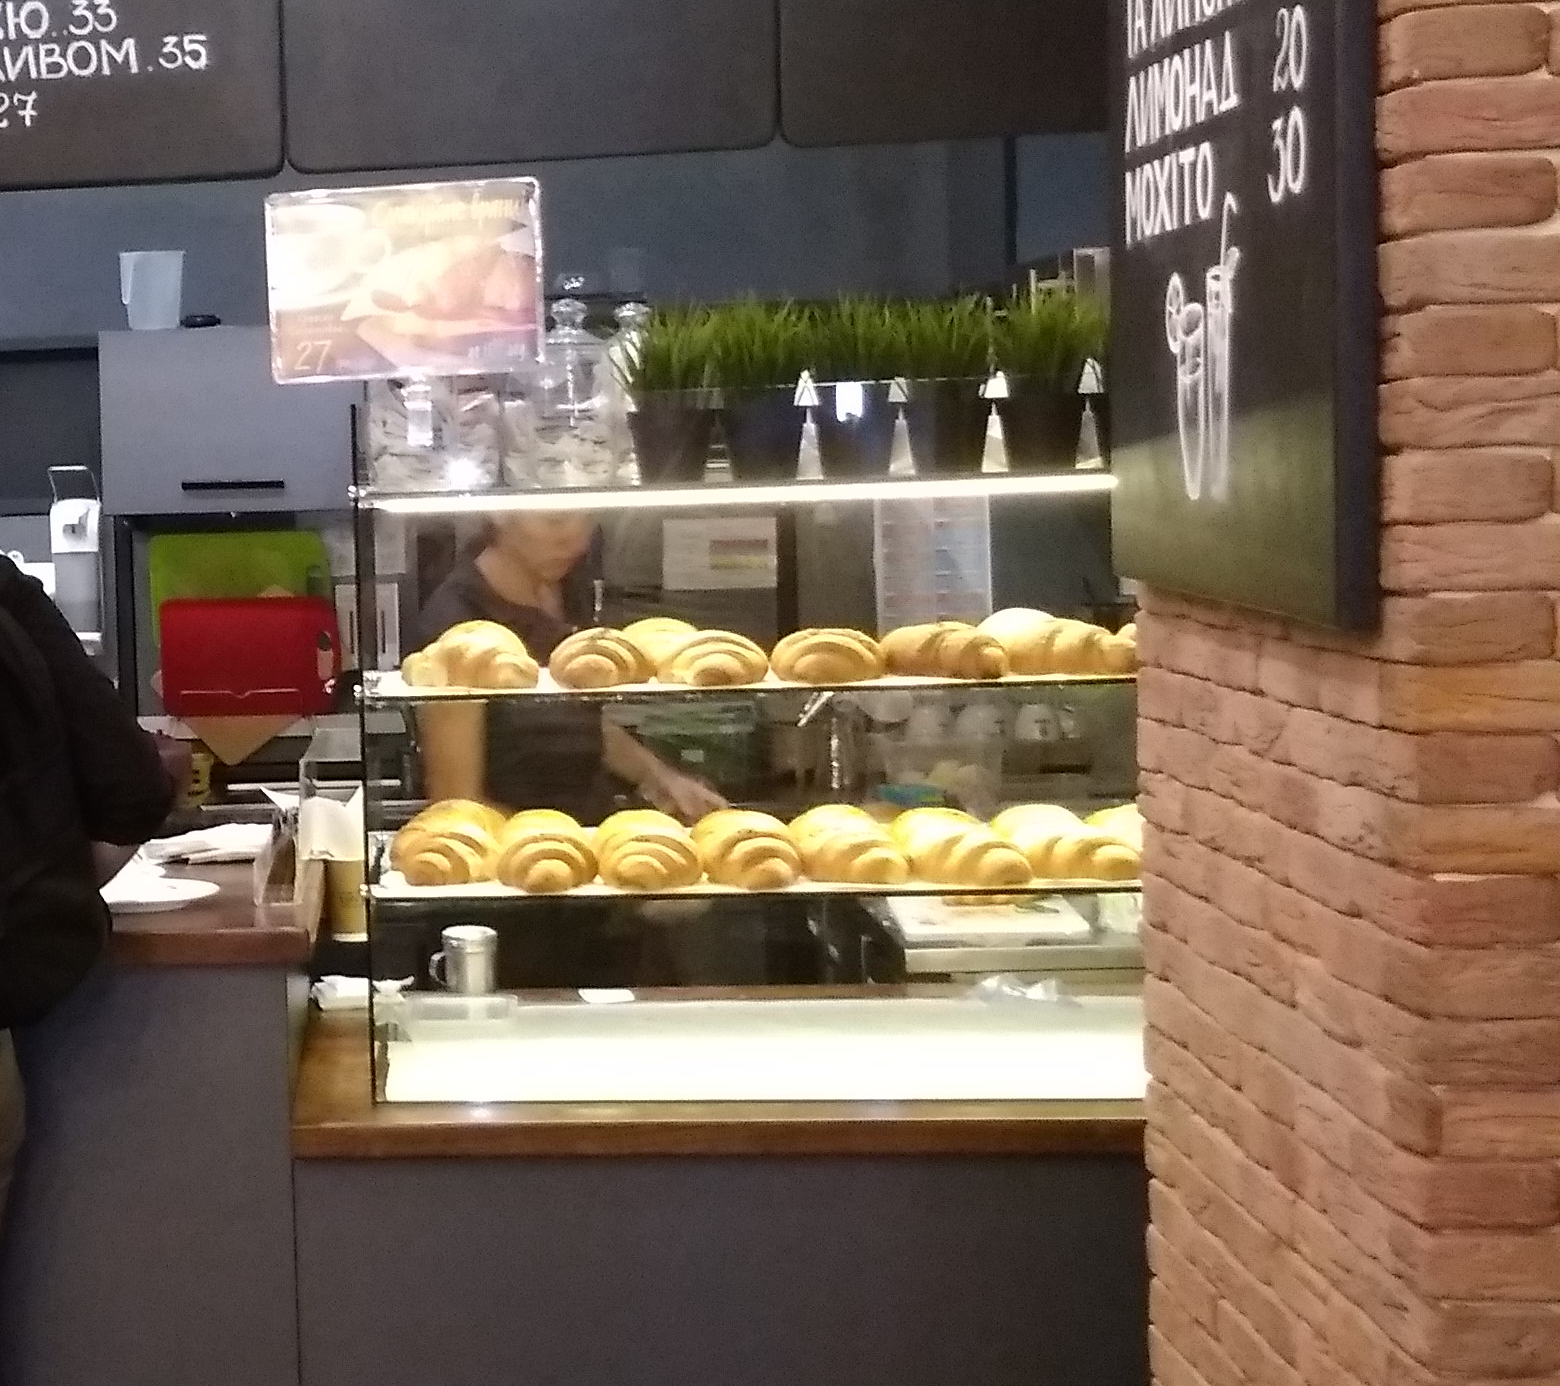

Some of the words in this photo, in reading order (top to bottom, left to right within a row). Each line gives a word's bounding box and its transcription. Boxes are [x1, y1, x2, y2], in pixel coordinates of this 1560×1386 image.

[158, 34, 208, 70] 35
[1124, 30, 1240, 154] ЛИМОНАД
[1271, 4, 1308, 93] 20
[1125, 141, 1214, 247] МОХІТО
[1266, 105, 1307, 206] 30
[295, 340, 333, 374] 27
